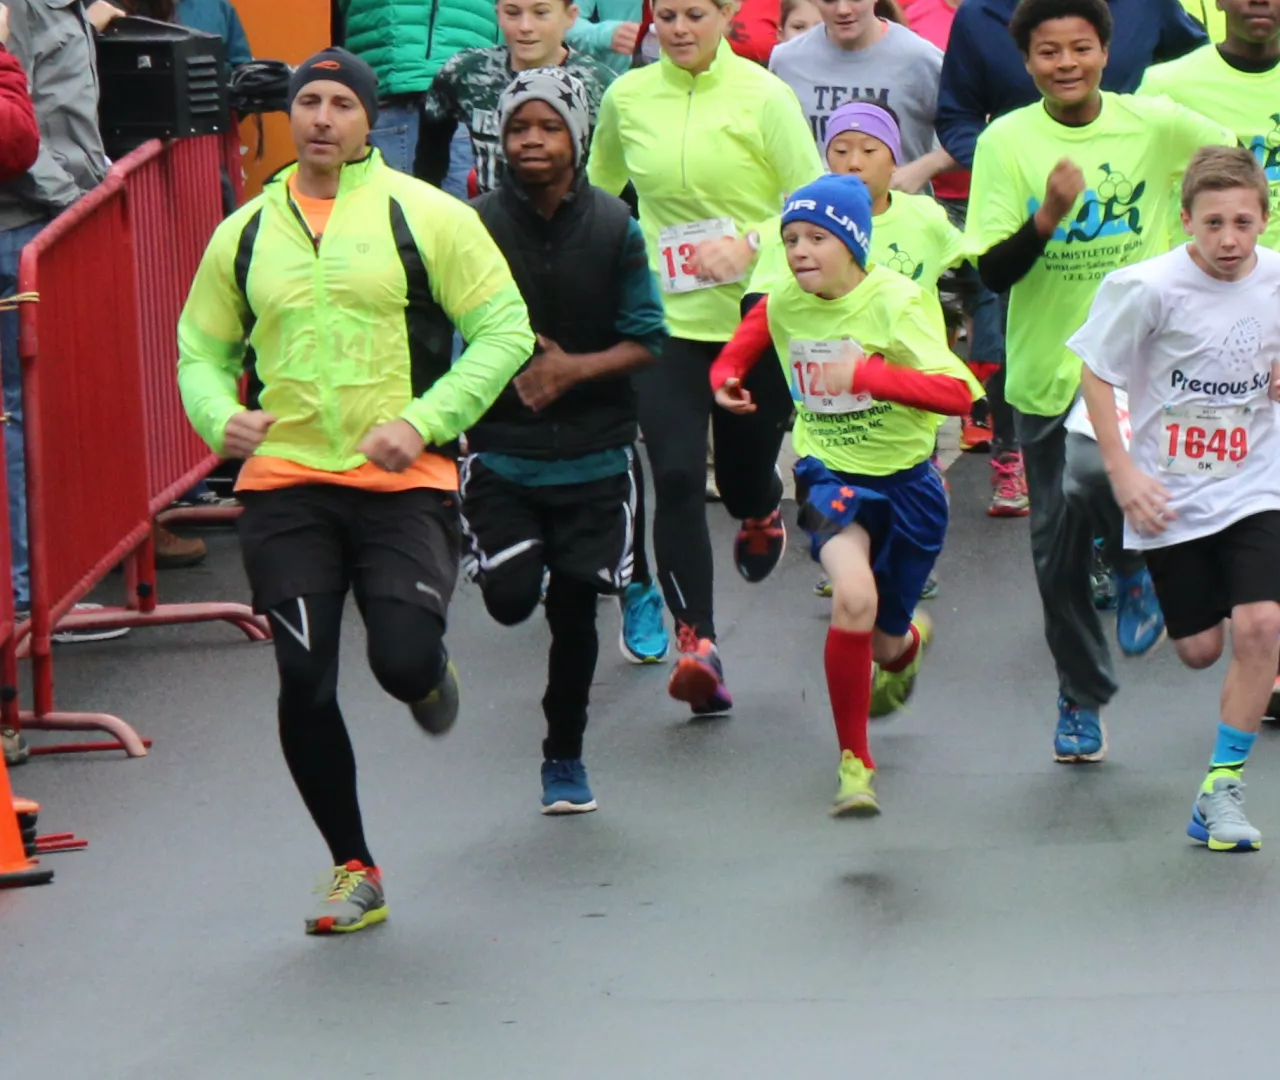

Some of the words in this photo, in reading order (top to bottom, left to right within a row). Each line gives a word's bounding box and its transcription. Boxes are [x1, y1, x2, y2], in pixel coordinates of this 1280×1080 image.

[1061, 245, 1121, 260] MISTLETOE
[1171, 369, 1248, 396] Precious
[868, 402, 893, 418] RUN
[868, 419, 884, 429] NC
[1166, 423, 1248, 462] 1649
[1198, 462, 1213, 471] 5K
